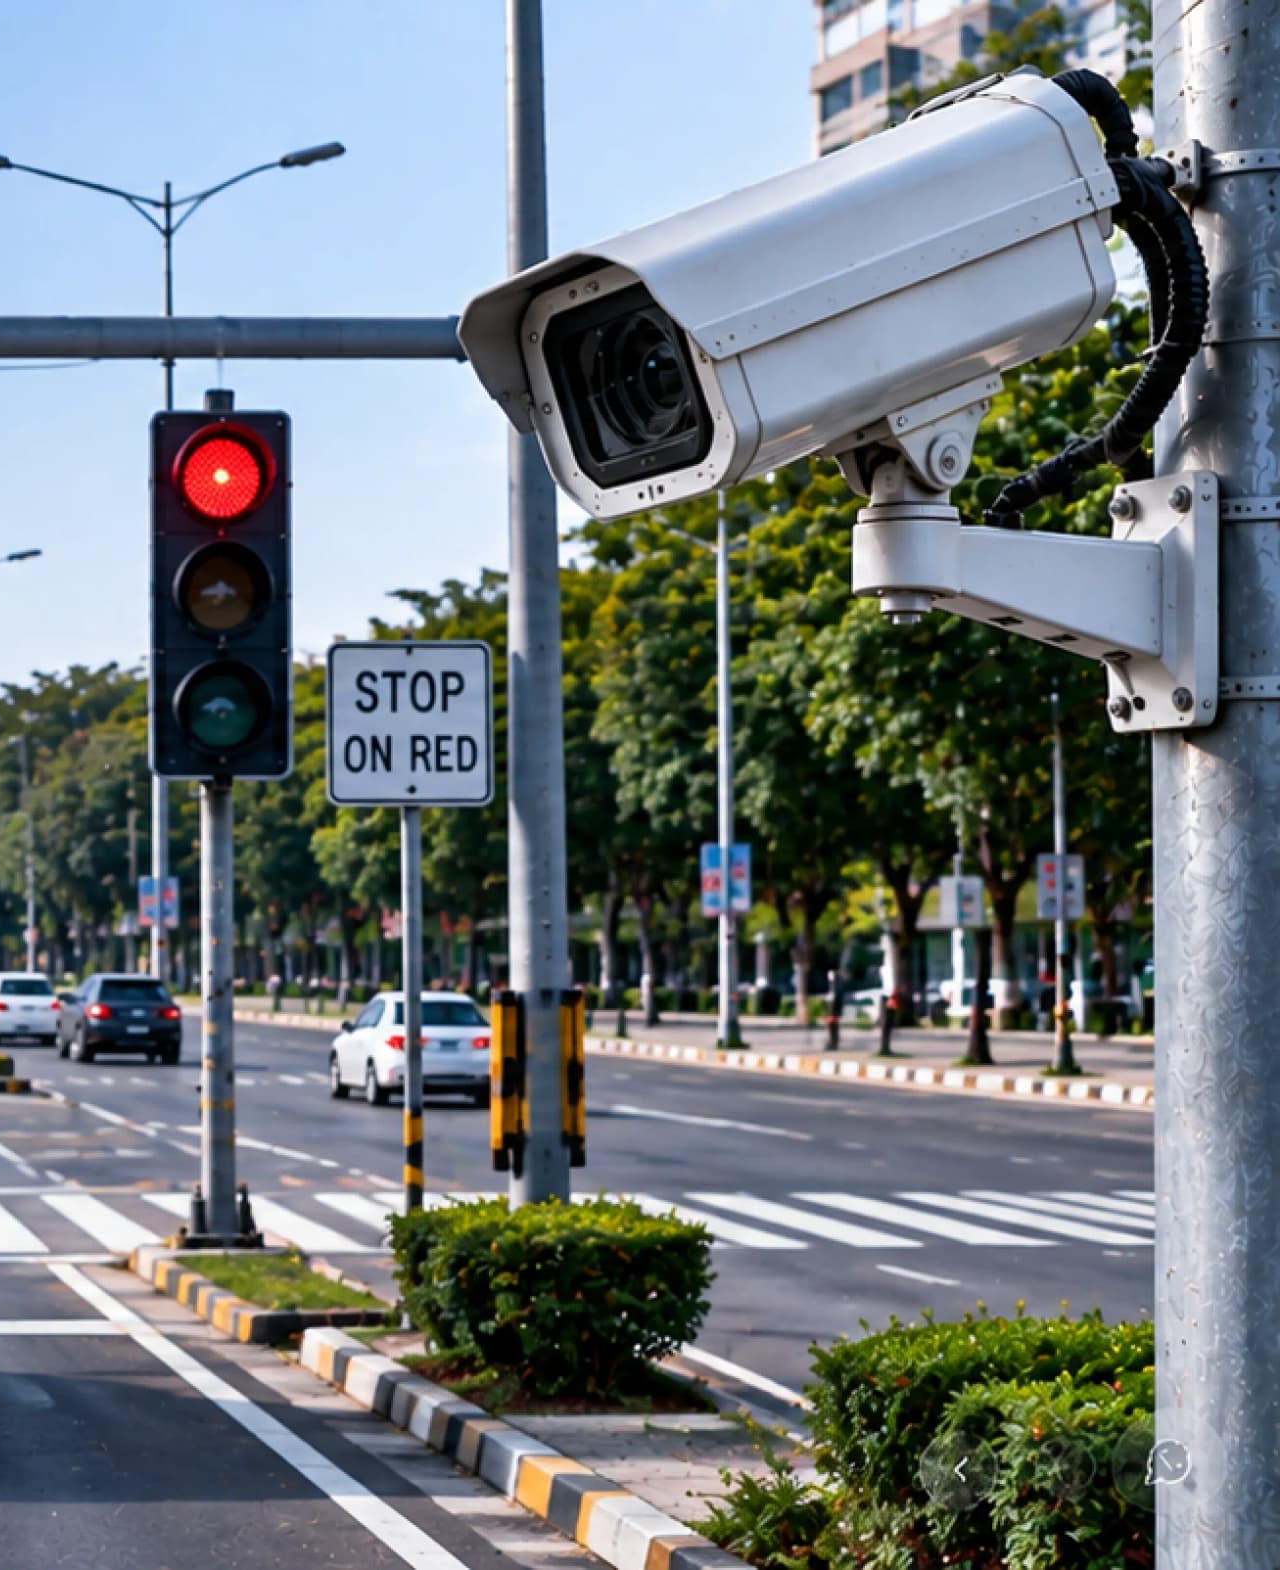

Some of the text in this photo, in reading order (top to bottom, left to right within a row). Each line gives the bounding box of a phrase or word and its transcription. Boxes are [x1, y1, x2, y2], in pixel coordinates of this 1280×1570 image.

[355, 670, 465, 713] STOP
[344, 735, 478, 773] ON RED
